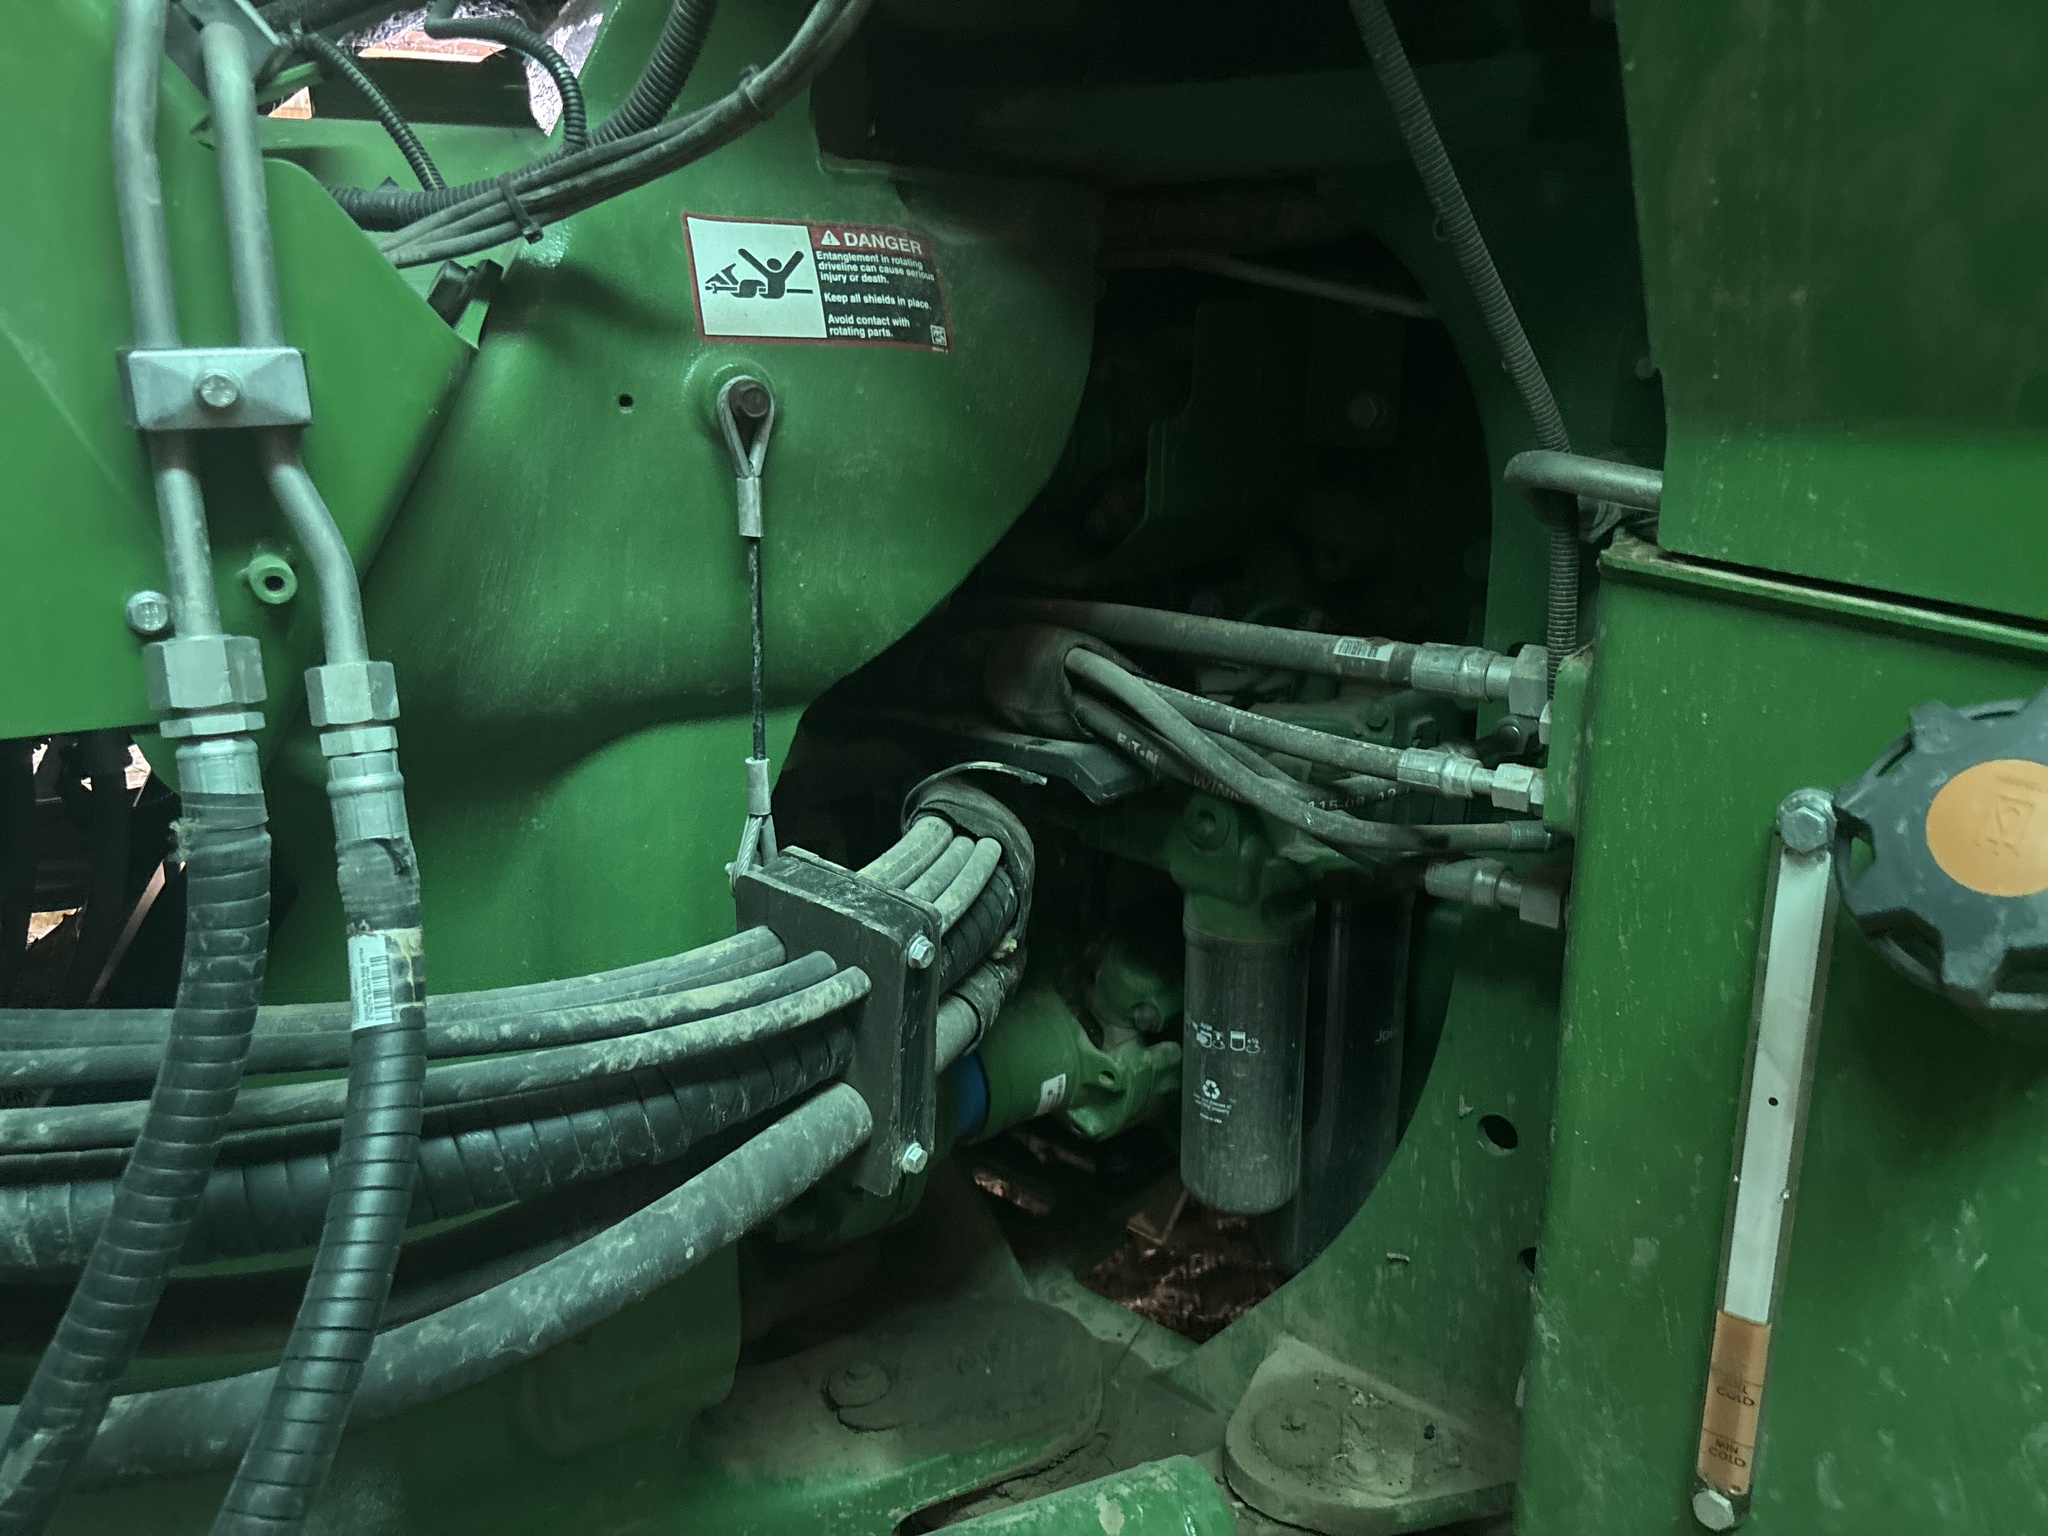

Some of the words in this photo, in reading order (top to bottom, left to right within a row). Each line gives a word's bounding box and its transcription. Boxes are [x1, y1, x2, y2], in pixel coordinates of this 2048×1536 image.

[843, 232, 922, 254] DANGER
[816, 251, 879, 263] Entanglement
[881, 254, 890, 263] in
[892, 257, 923, 270] rotating
[818, 261, 858, 272] driveline
[860, 264, 877, 273] can
[879, 265, 904, 276] cause
[906, 269, 935, 281] serious
[820, 272, 847, 283] injury
[849, 274, 859, 282] or
[862, 273, 889, 283] death.
[824, 292, 848, 304] Keep
[850, 293, 861, 303] all
[863, 294, 896, 305] shields
[897, 296, 906, 306] in
[907, 298, 932, 310] place.
[828, 314, 854, 325] Avoid
[856, 315, 890, 326] contact
[892, 316, 910, 327] with
[829, 326, 866, 339] rotating
[868, 328, 894, 339] parts.
[1708, 1447, 1747, 1468] COLD
